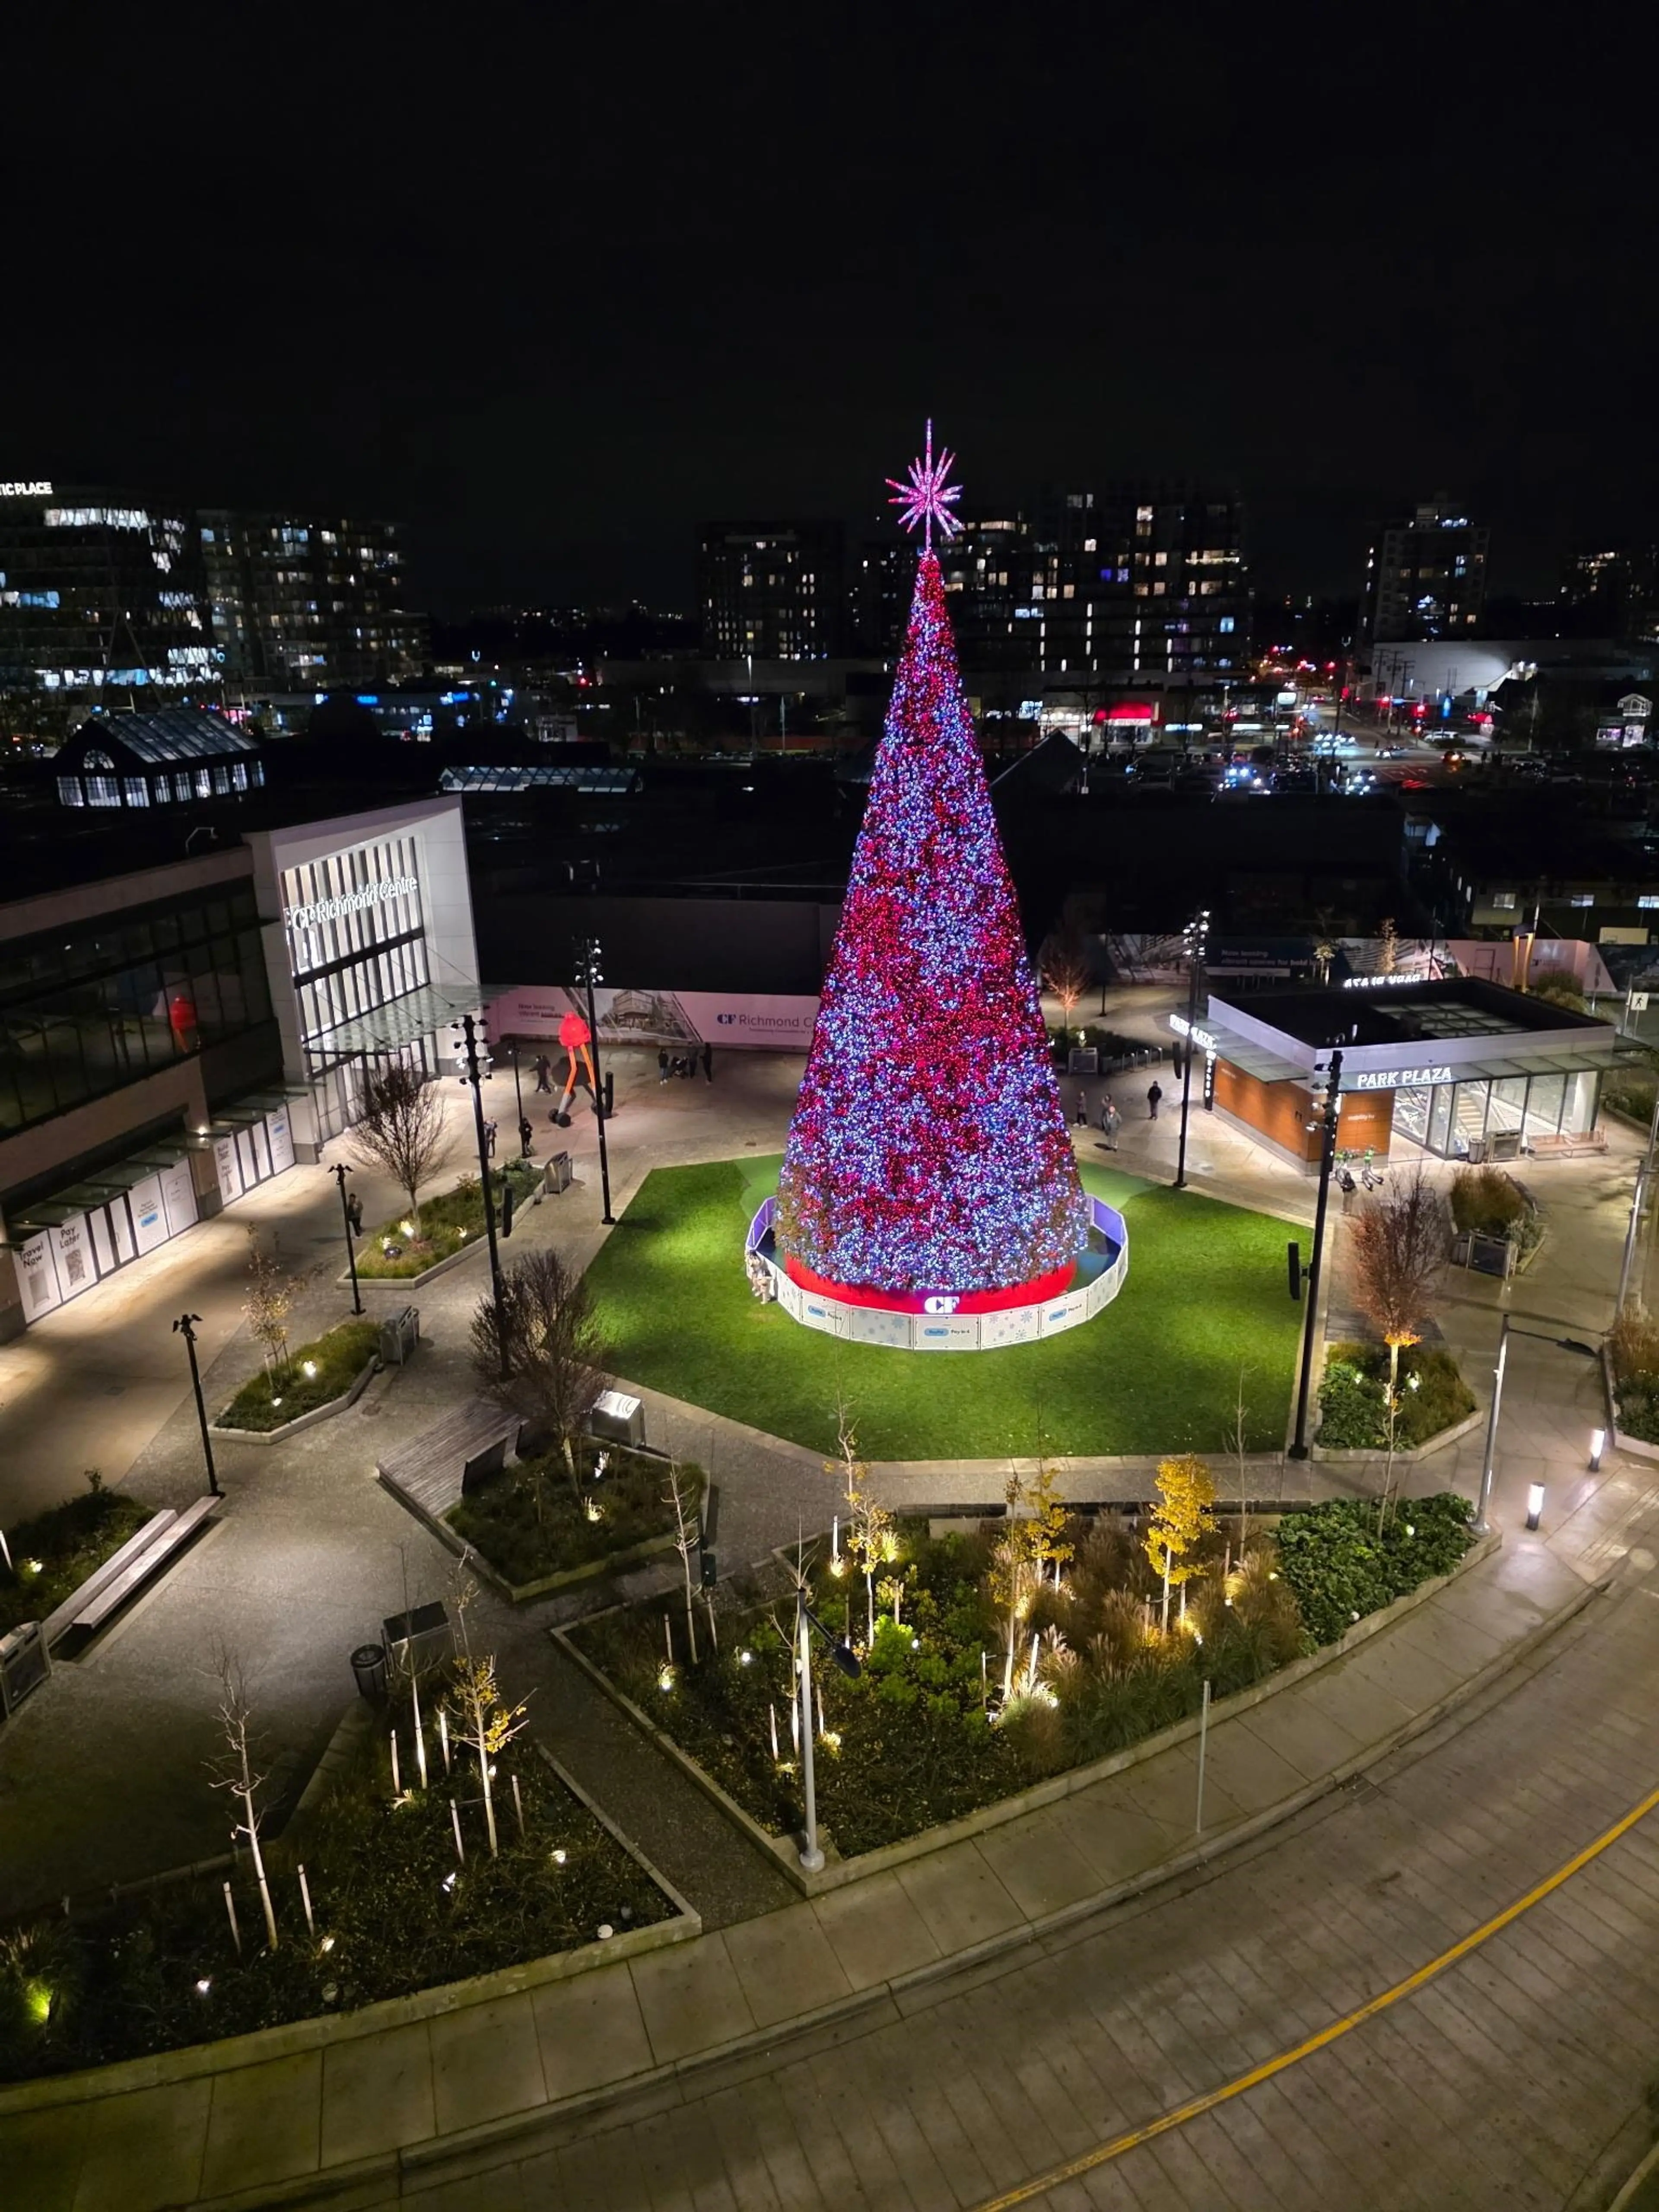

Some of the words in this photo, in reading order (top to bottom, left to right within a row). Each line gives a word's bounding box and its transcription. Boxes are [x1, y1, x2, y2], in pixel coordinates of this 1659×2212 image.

[14, 481, 53, 496] PLACE
[317, 884, 379, 924] Richmond
[378, 876, 418, 901] Centre
[717, 1014, 736, 1024] CF
[739, 1014, 799, 1027] Richmond
[1357, 1071, 1399, 1088] PARK
[1402, 1067, 1451, 1084] PLAZA
[60, 1226, 76, 1239] Pay
[59, 1233, 80, 1249] Later
[19, 1241, 44, 1260] Travel
[23, 1255, 42, 1269] Now
[925, 1296, 960, 1314] CF
